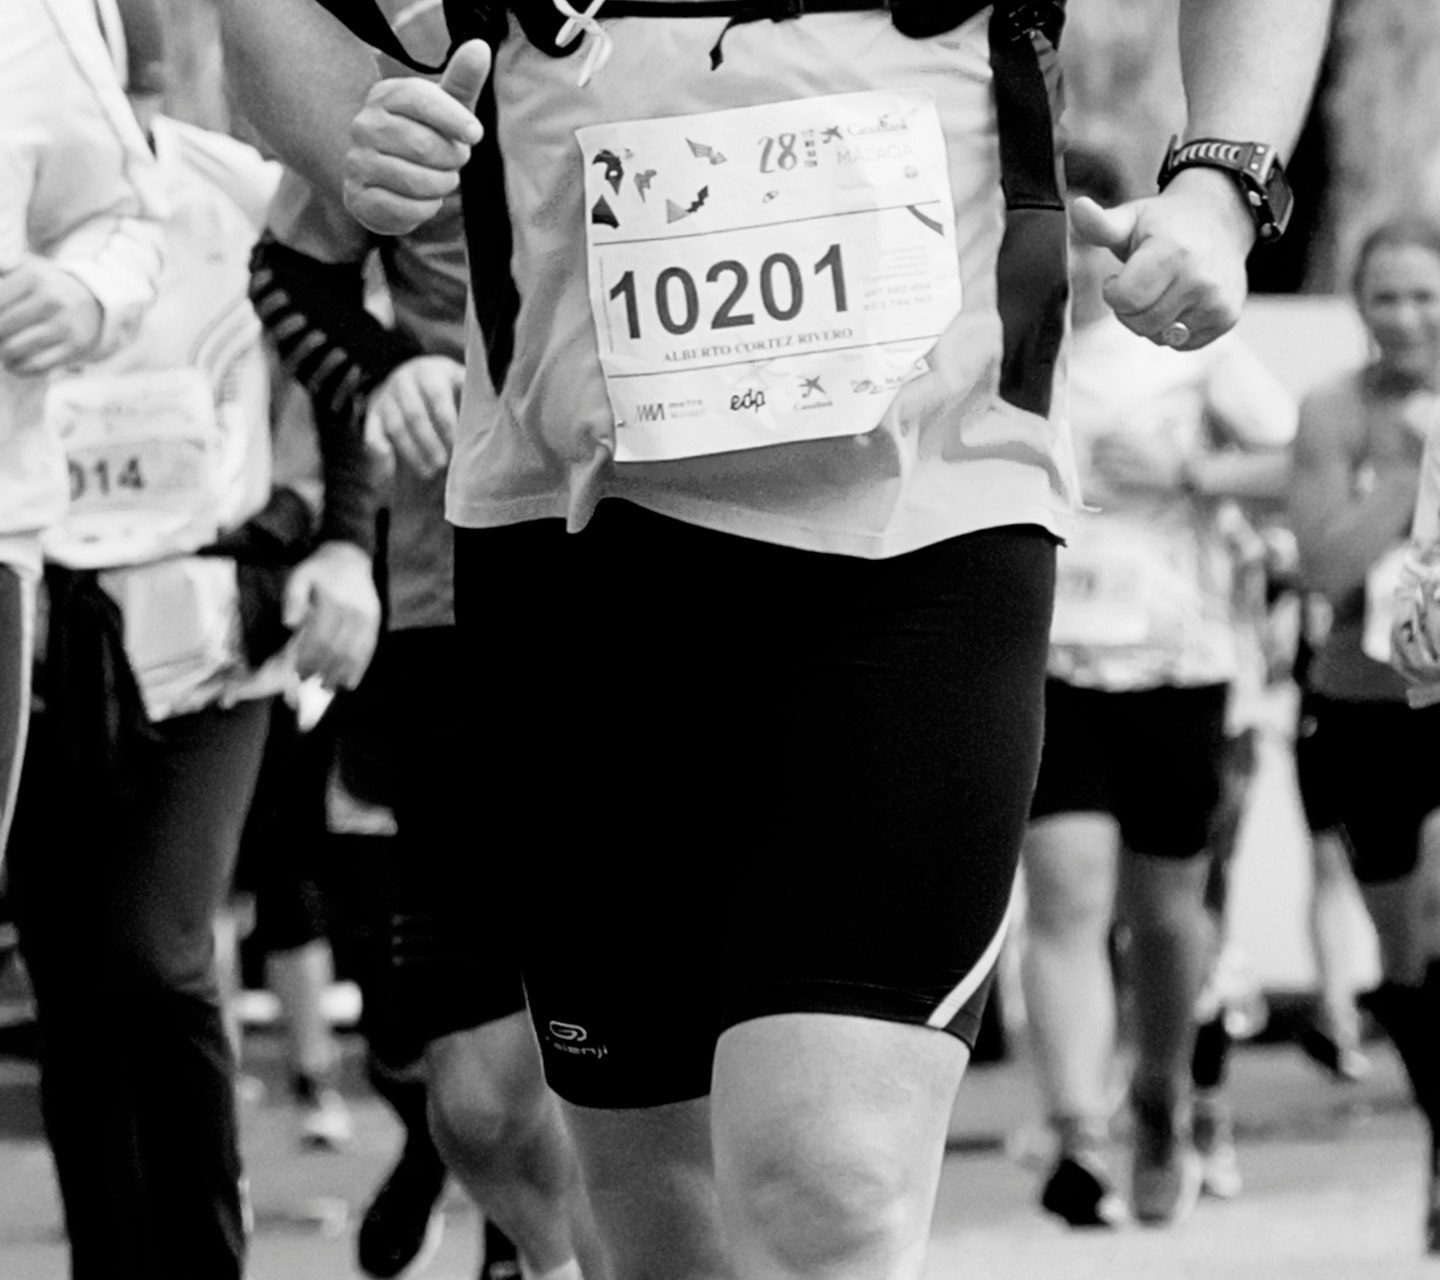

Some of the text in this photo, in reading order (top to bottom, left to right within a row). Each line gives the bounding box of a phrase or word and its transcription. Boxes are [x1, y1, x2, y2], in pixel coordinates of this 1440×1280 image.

[608, 243, 848, 340] 10201
[662, 327, 854, 363] ALBERTO CORTEZ RIVERO
[730, 387, 767, 413] edp
